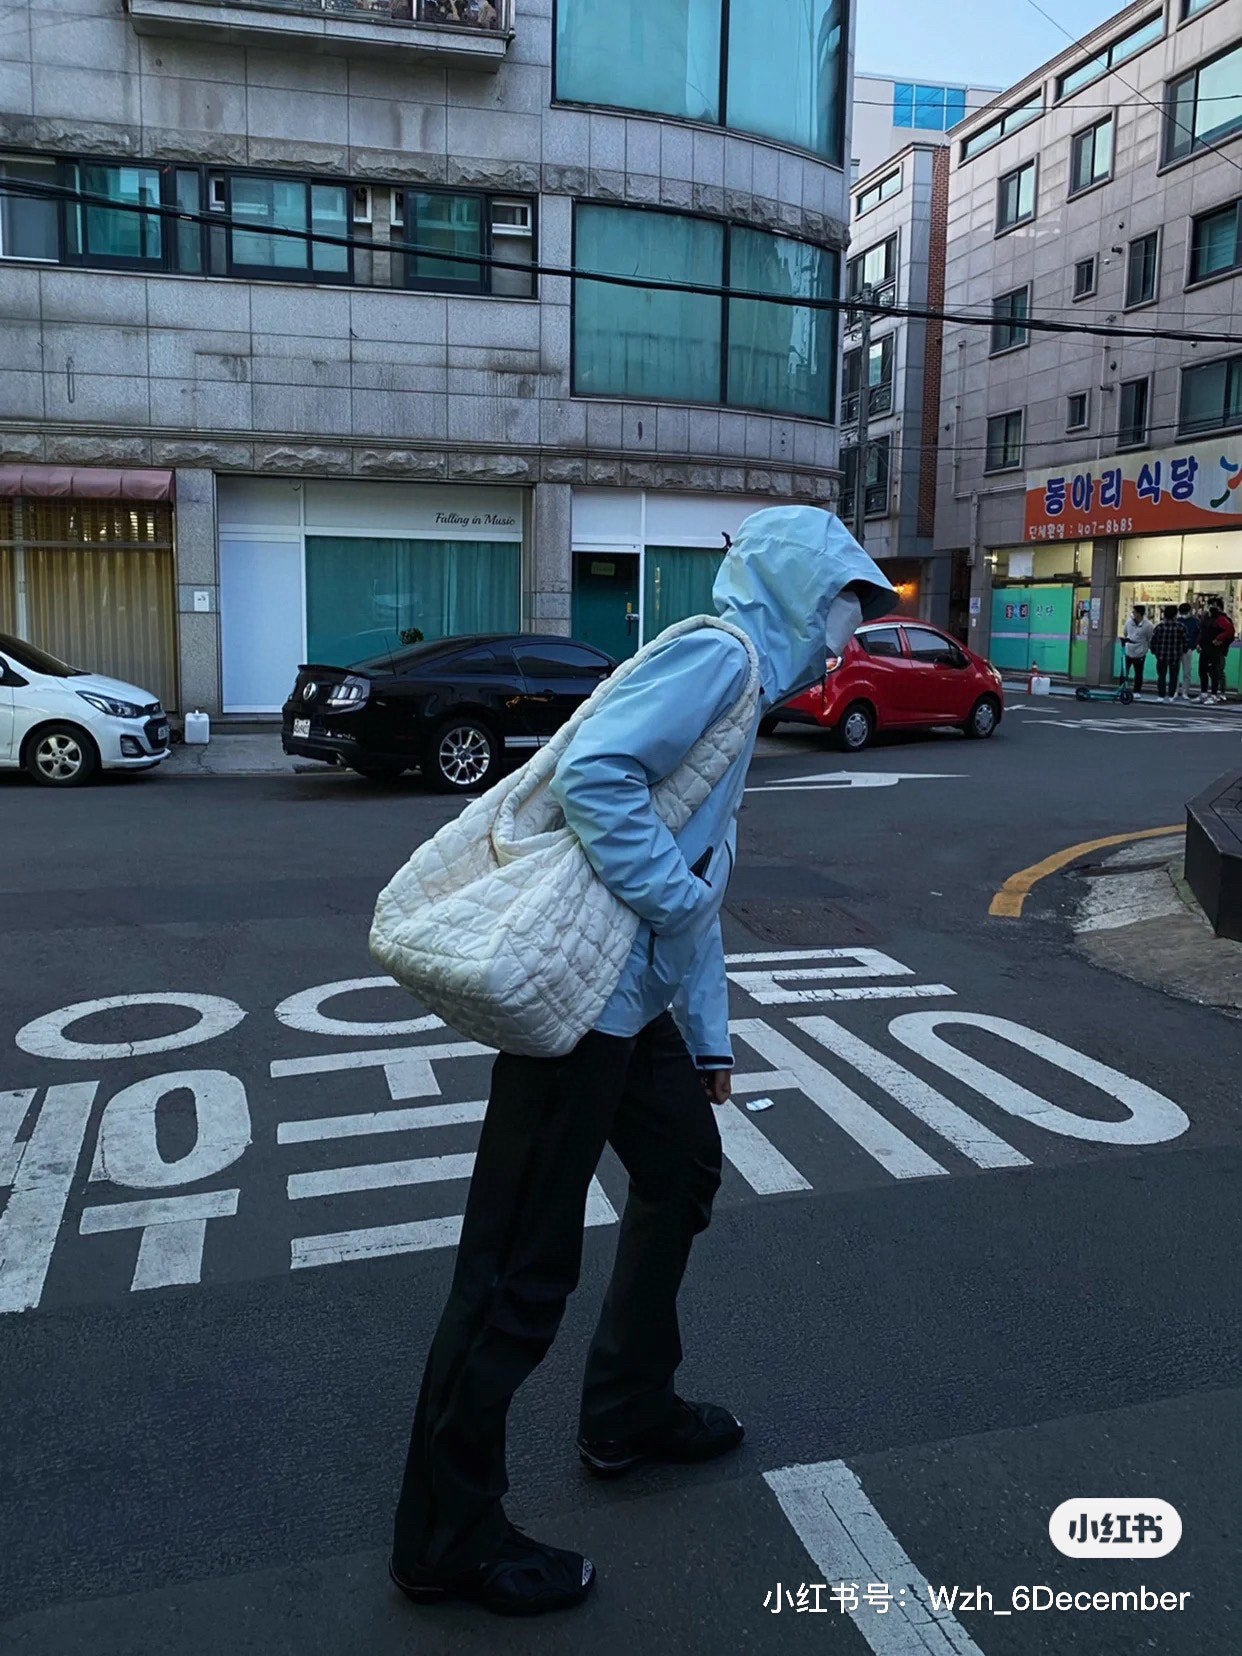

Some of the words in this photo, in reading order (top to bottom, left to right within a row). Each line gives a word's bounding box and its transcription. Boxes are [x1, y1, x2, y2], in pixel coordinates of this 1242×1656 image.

[1045, 467, 1122, 516] 동아리
[1136, 455, 1199, 505] 식당
[435, 512, 470, 527] Falling
[472, 516, 482, 525] in
[484, 514, 516, 526] Music
[1029, 523, 1066, 540] 단체환영
[1077, 518, 1133, 536] 407-8685
